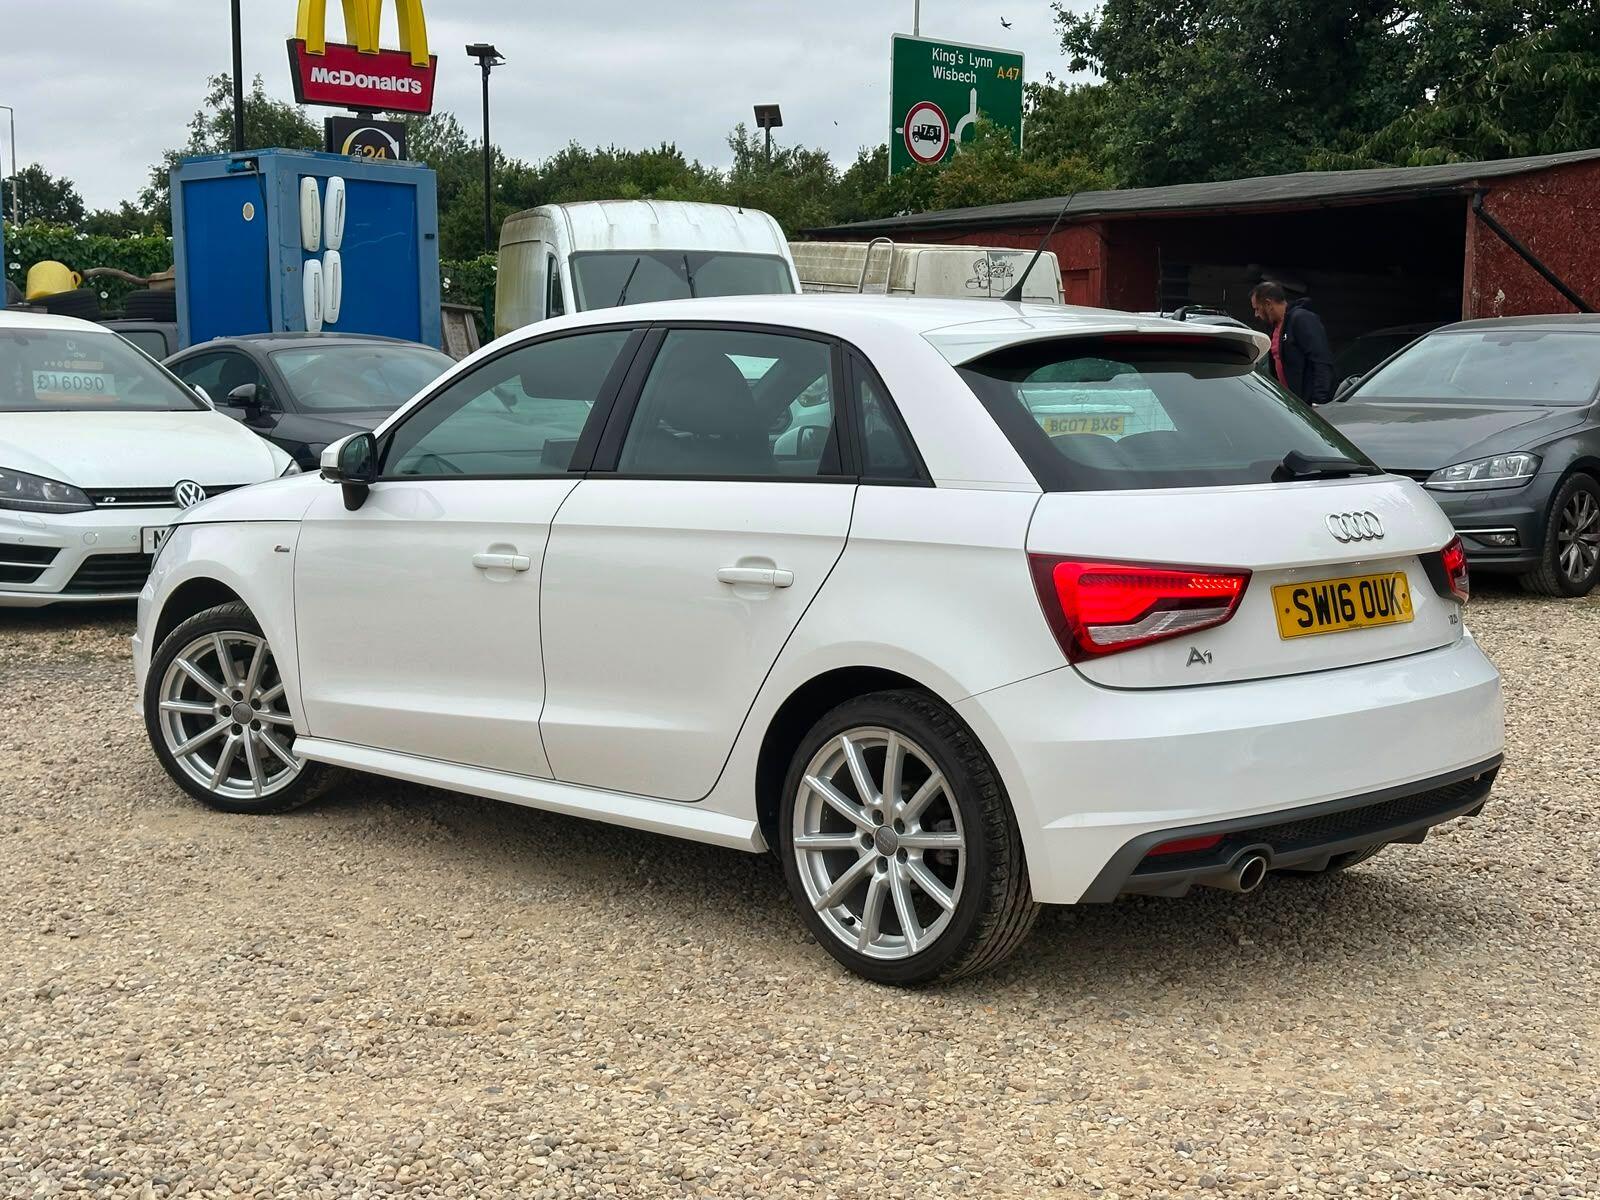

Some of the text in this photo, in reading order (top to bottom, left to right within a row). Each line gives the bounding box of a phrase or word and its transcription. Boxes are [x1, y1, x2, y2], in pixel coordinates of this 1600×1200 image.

[932, 48, 993, 69] King's Lynn
[310, 67, 422, 94] McDonald's
[932, 65, 977, 83] Wisbech
[996, 66, 1020, 81] A47
[363, 145, 388, 160] 24
[1292, 577, 1404, 628] SW16 OUK
[1185, 647, 1213, 667] A1
